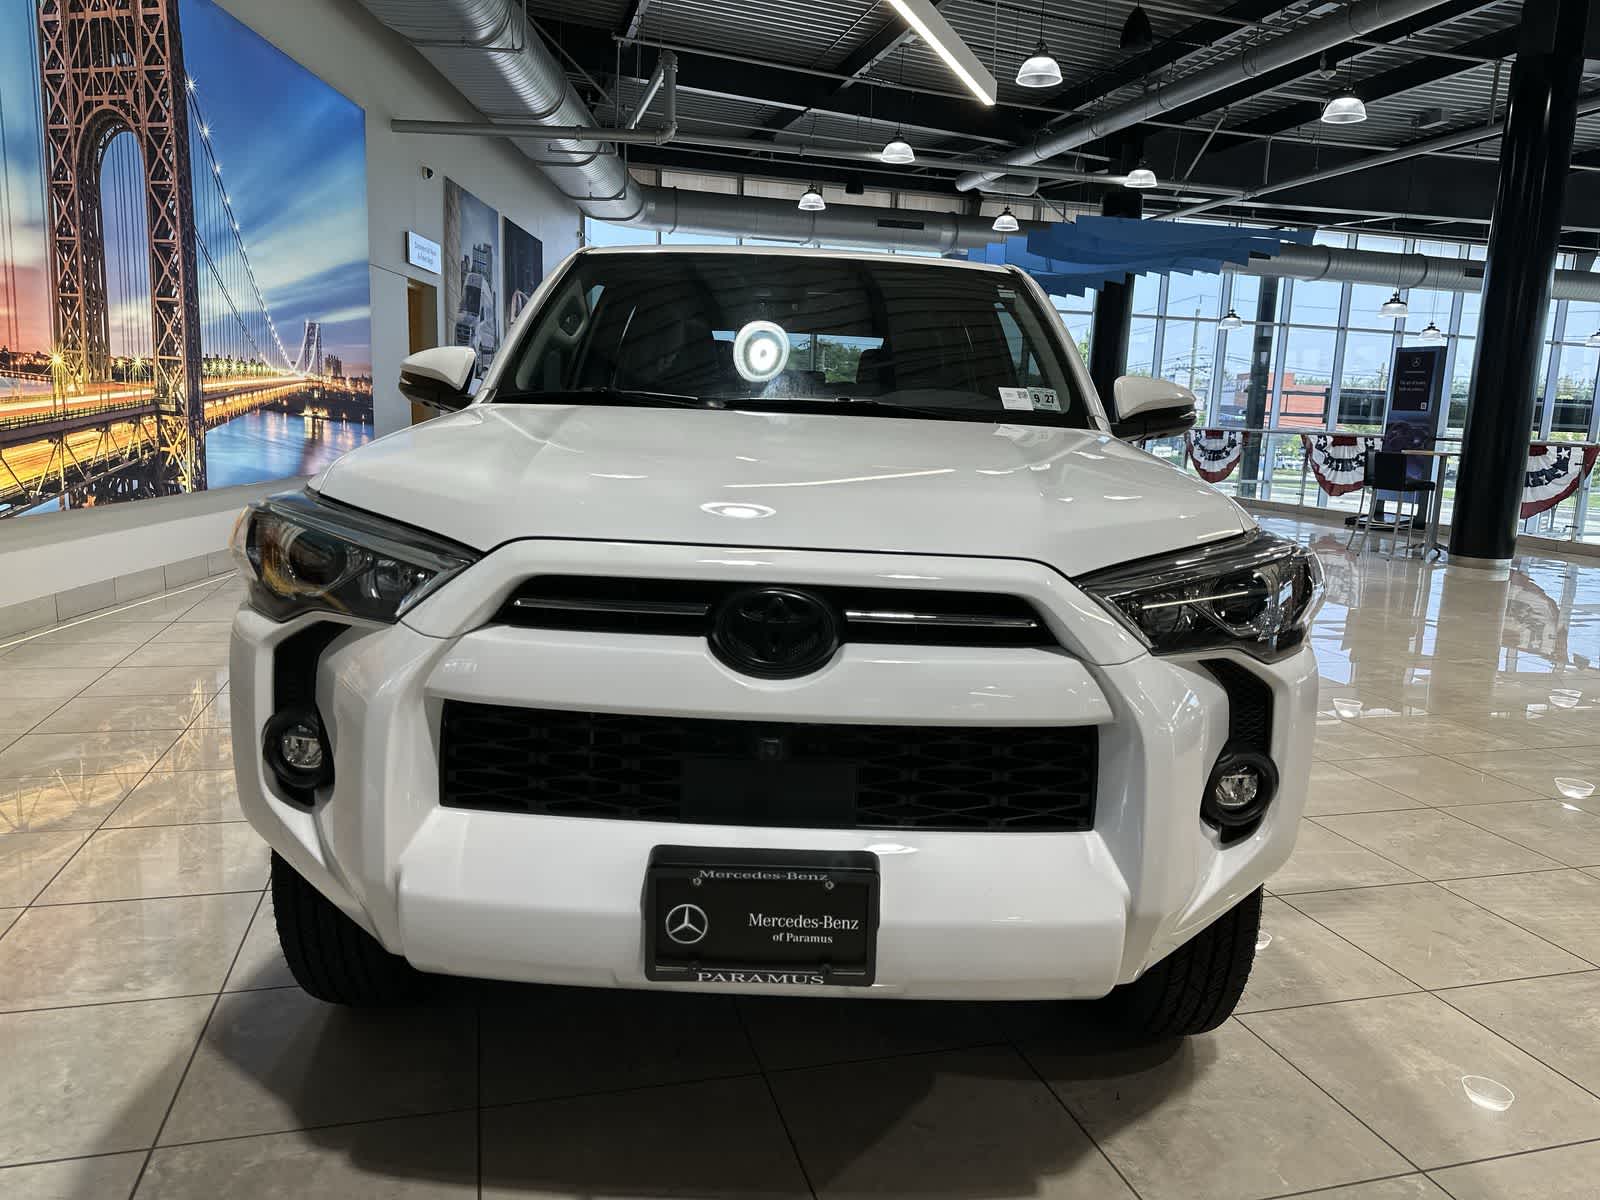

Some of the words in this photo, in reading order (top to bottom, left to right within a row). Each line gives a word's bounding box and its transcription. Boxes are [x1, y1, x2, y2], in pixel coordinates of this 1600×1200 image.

[1034, 394, 1040, 403] 9
[1045, 394, 1054, 403] 27
[699, 869, 829, 881] Mercedes-Benz
[749, 913, 859, 930] Mercedes-Benz
[772, 932, 785, 943] of
[786, 933, 833, 944] Paramus
[696, 972, 825, 985] PARAMUS
